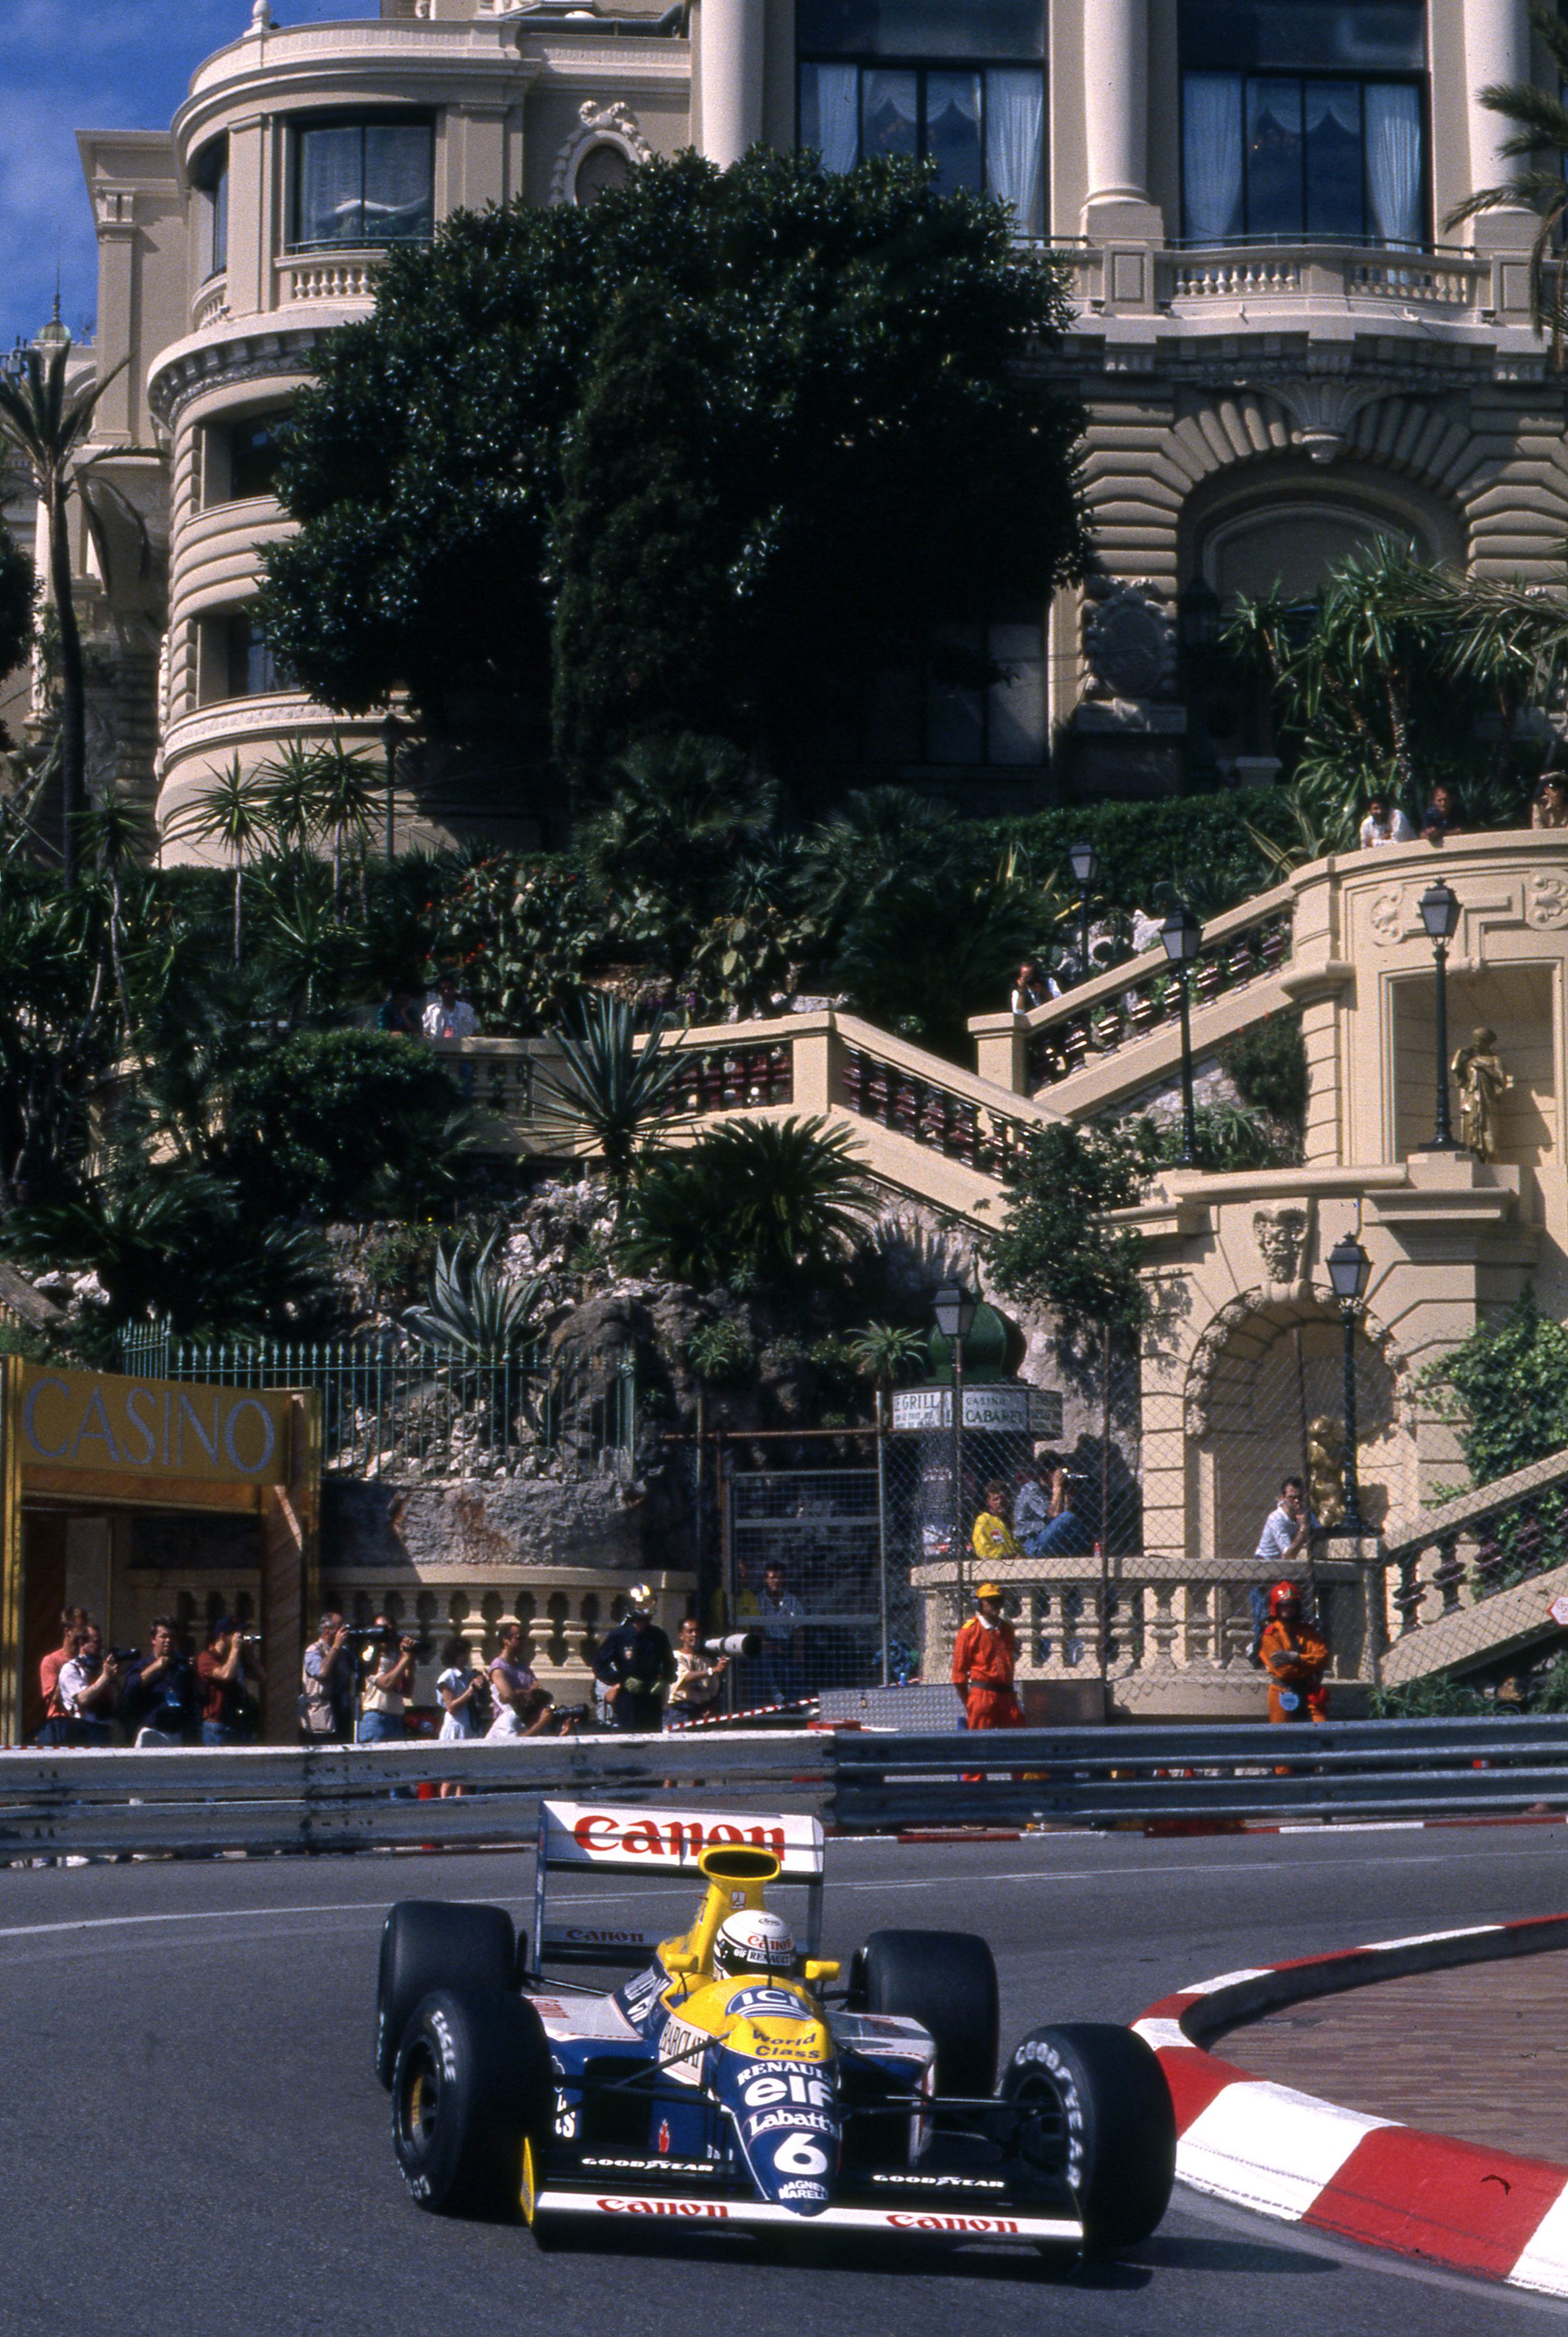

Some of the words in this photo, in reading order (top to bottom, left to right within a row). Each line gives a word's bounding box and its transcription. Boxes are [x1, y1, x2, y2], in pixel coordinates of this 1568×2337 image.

[902, 1394, 939, 1410] GRILL
[24, 1377, 274, 1473] CASINO
[574, 1815, 785, 1861] Canon
[566, 1929, 644, 1943] Canon
[734, 1948, 748, 1958] elf
[742, 1989, 800, 2008] ICI
[753, 2028, 816, 2046] World
[755, 2045, 821, 2059] Class
[745, 2075, 833, 2107] elf
[774, 2133, 829, 2175] 6
[582, 2158, 714, 2172] GOODYEAR
[873, 2175, 1006, 2188] GOODYEAR
[596, 2198, 729, 2218] Canon
[886, 2214, 1019, 2233] Canon
